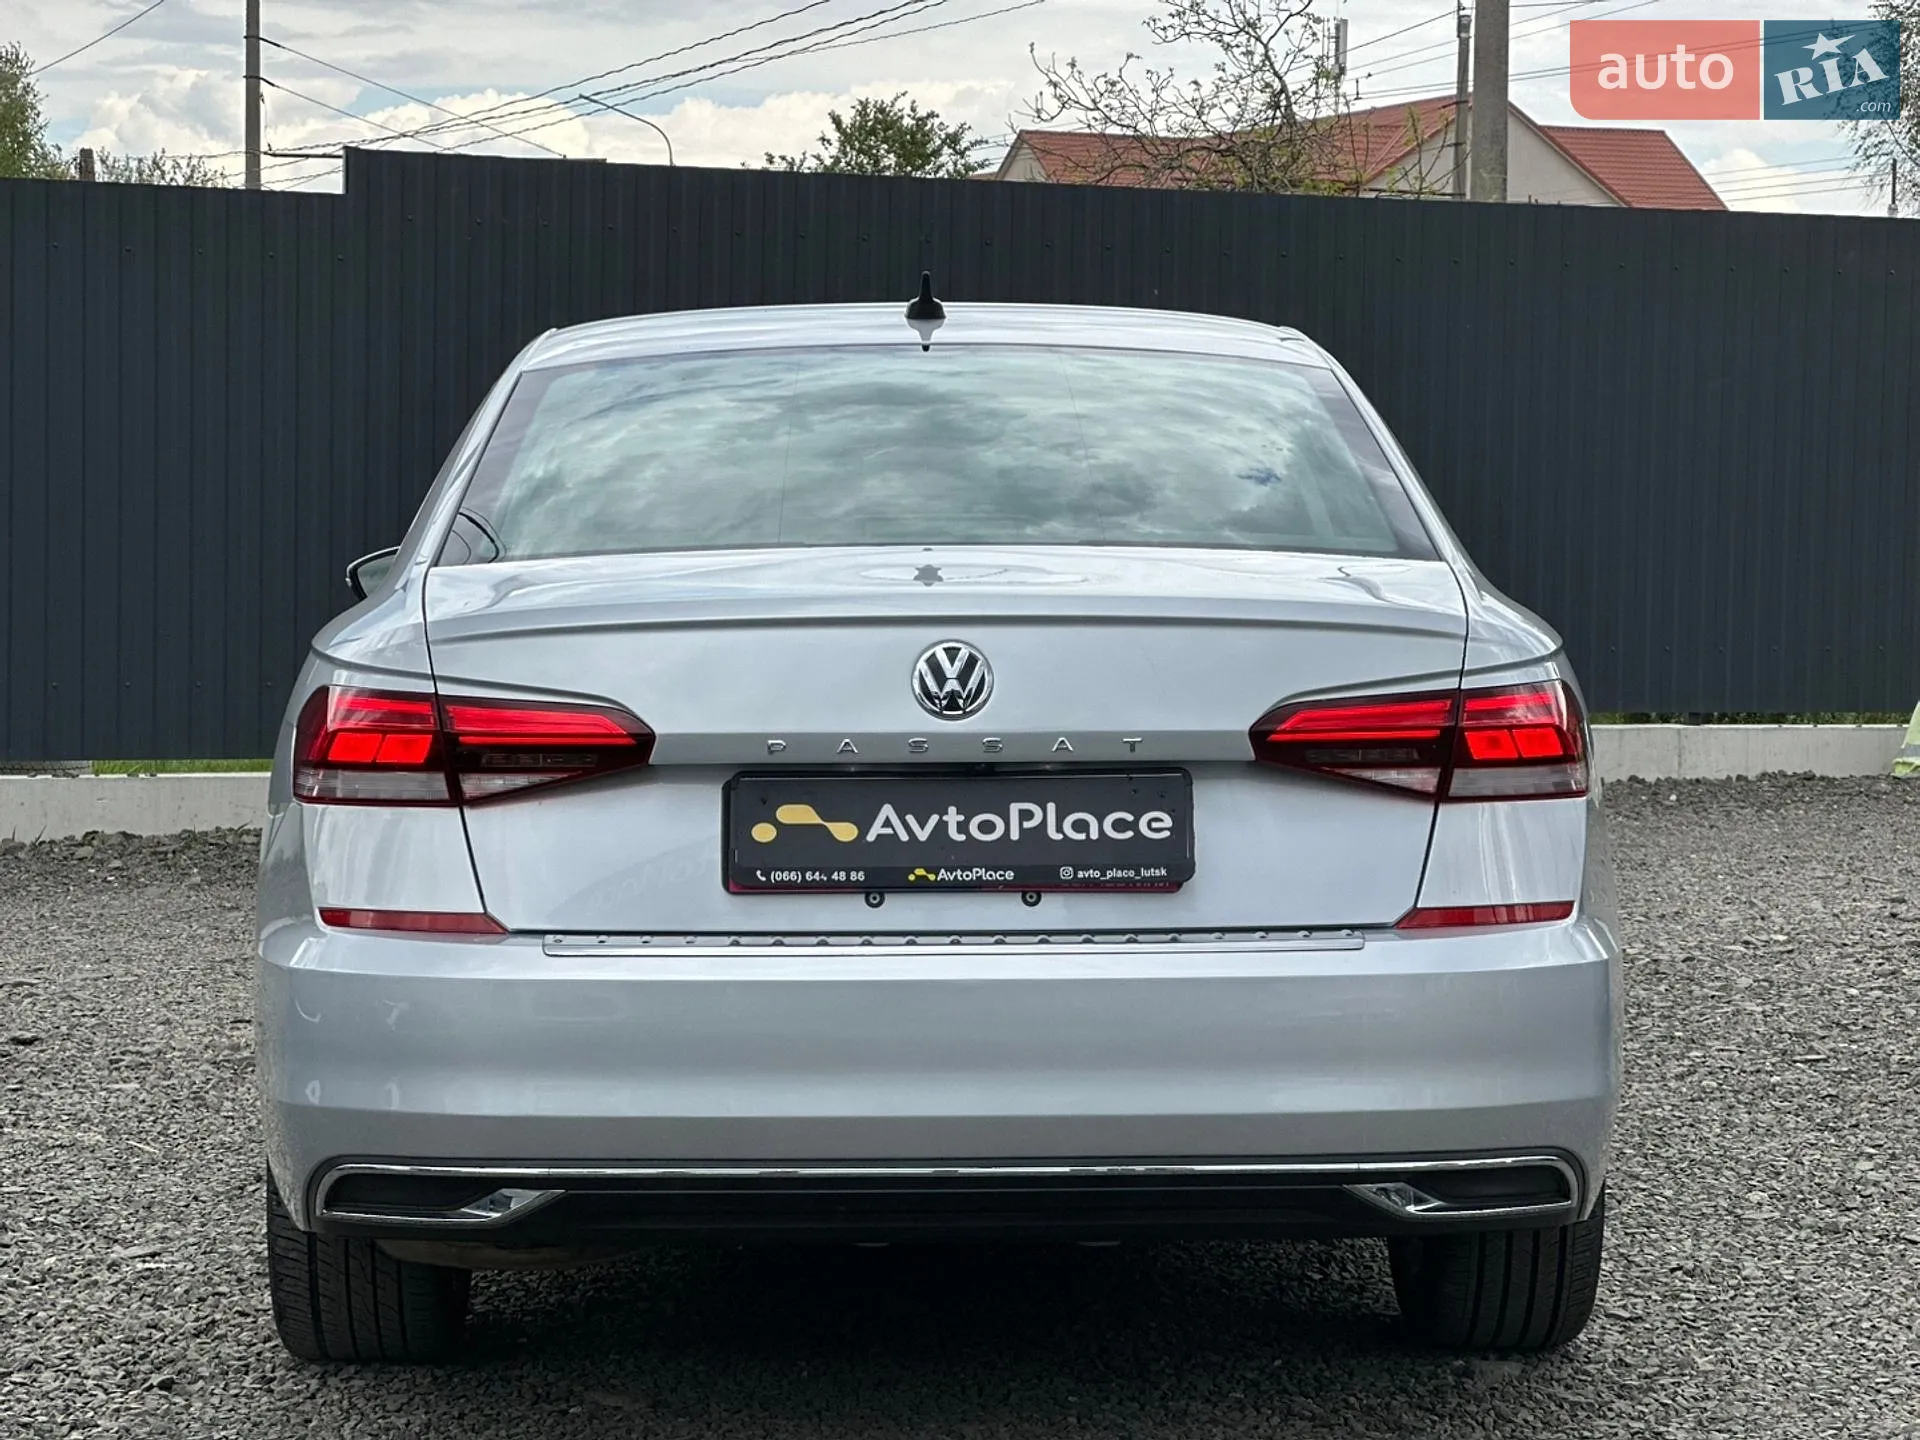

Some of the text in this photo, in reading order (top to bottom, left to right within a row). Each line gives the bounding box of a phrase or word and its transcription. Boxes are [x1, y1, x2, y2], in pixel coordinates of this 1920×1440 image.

[766, 737, 1144, 755] PASSAT
[865, 802, 1174, 842] AvtoPlace
[770, 870, 802, 884] (066)
[831, 870, 847, 882] 48
[849, 870, 866, 882] 86
[937, 867, 1015, 881] AvtoPlace
